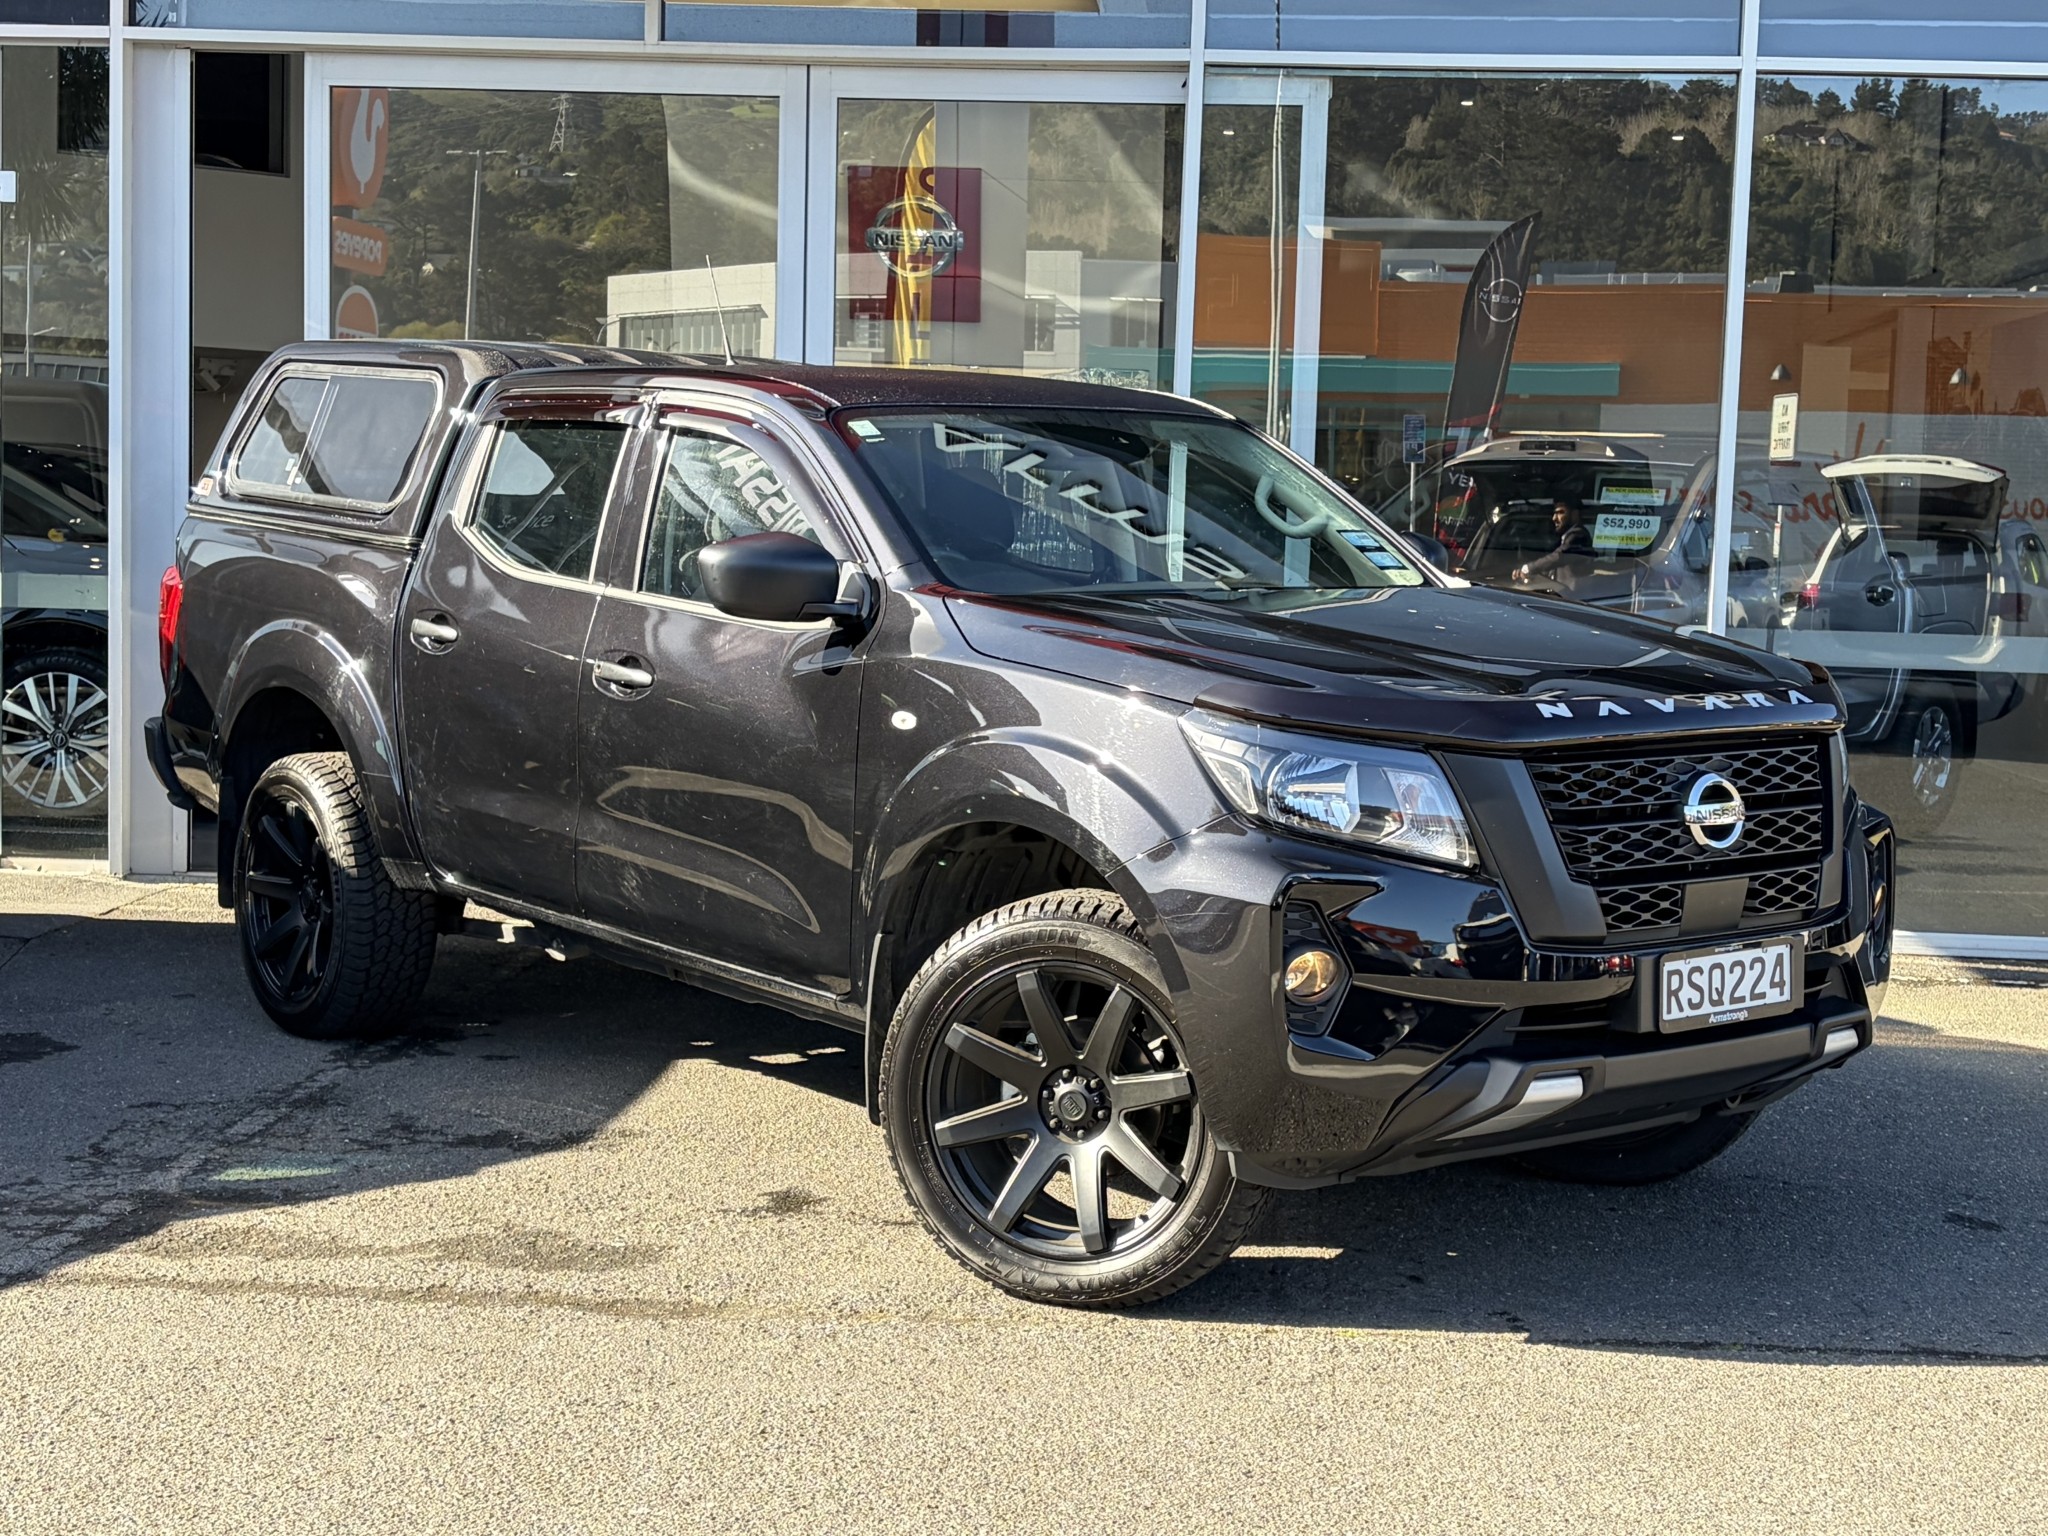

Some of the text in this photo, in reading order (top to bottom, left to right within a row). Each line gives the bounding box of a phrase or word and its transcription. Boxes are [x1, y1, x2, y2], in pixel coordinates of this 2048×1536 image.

[873, 232, 954, 250] NISSAN
[1602, 517, 1651, 531] $52,990
[1535, 689, 1814, 719] NAVARA
[1666, 952, 1786, 1015] RSQ224
